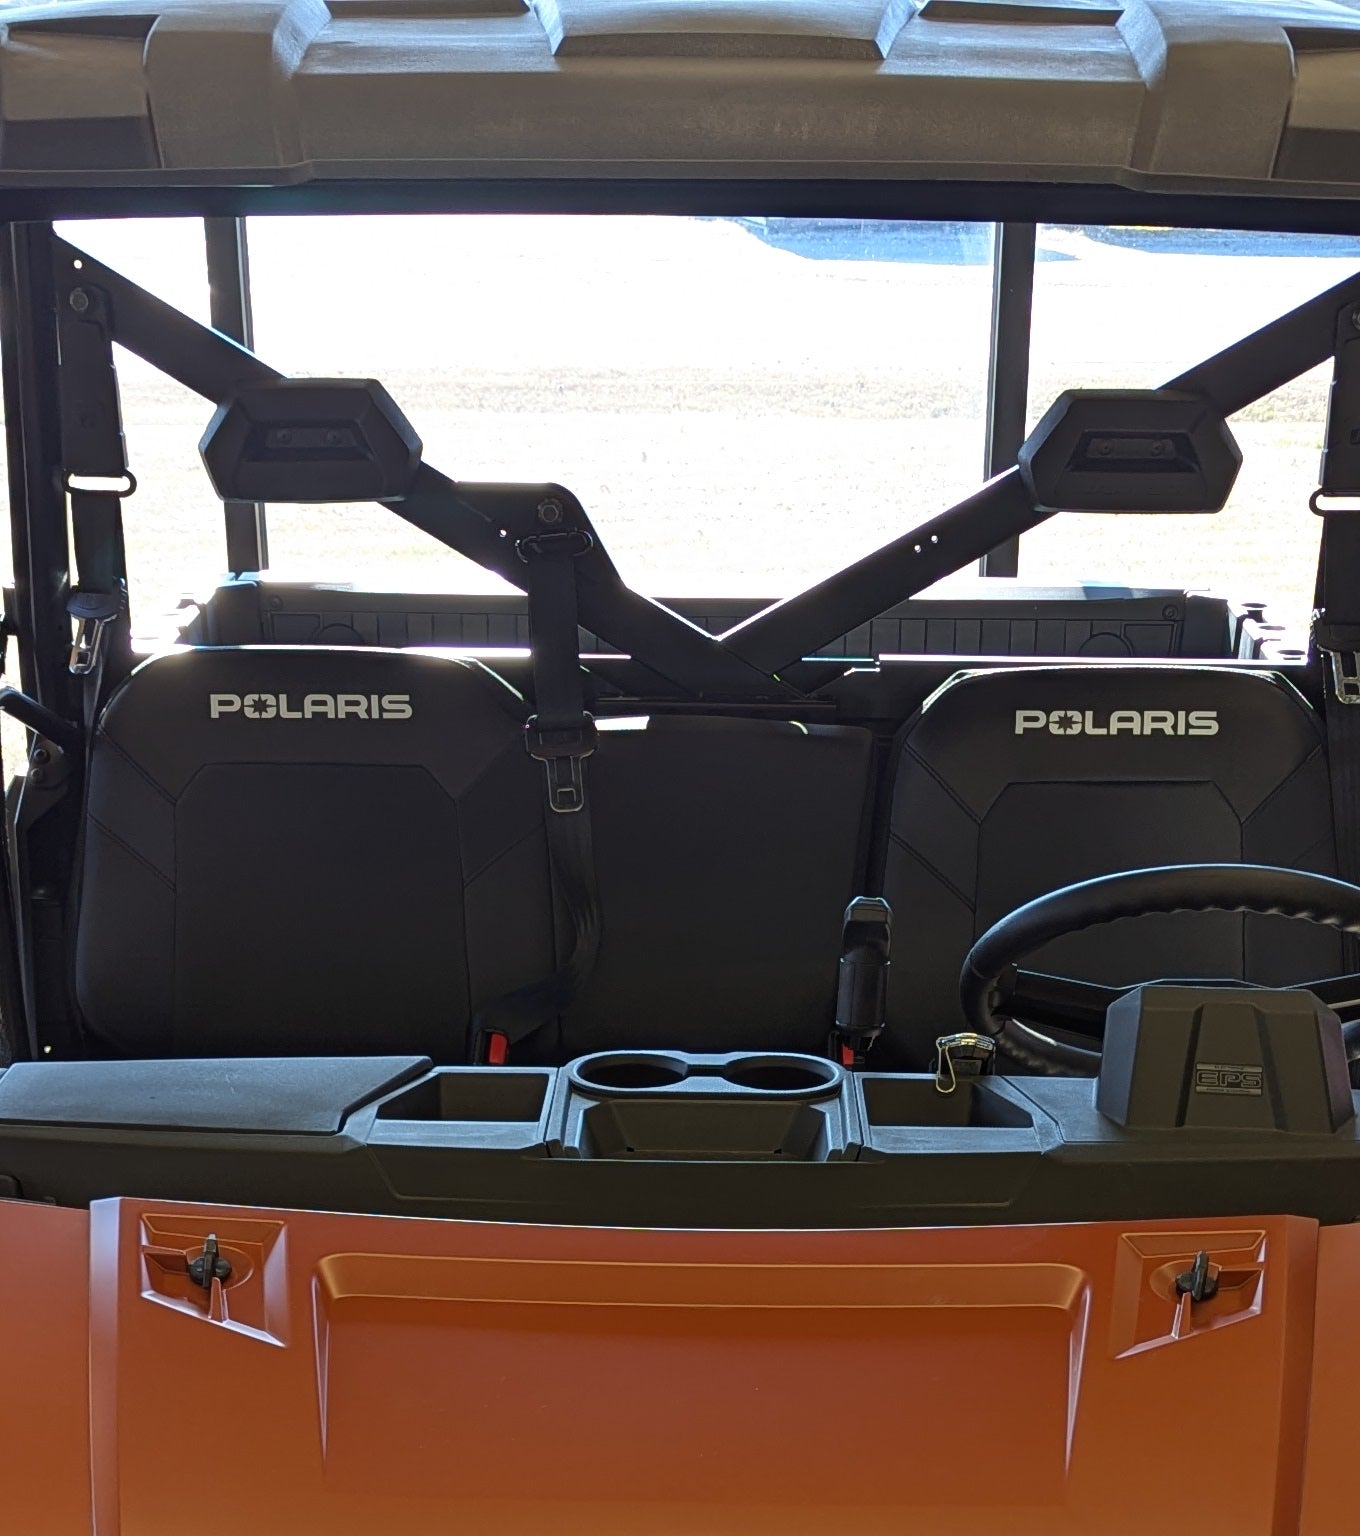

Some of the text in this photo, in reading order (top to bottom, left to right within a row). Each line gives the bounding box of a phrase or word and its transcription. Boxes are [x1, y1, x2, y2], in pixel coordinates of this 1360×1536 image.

[209, 693, 413, 719] POLARIS
[1014, 709, 1220, 736] POLARIS
[1196, 1070, 1262, 1088] EPS
